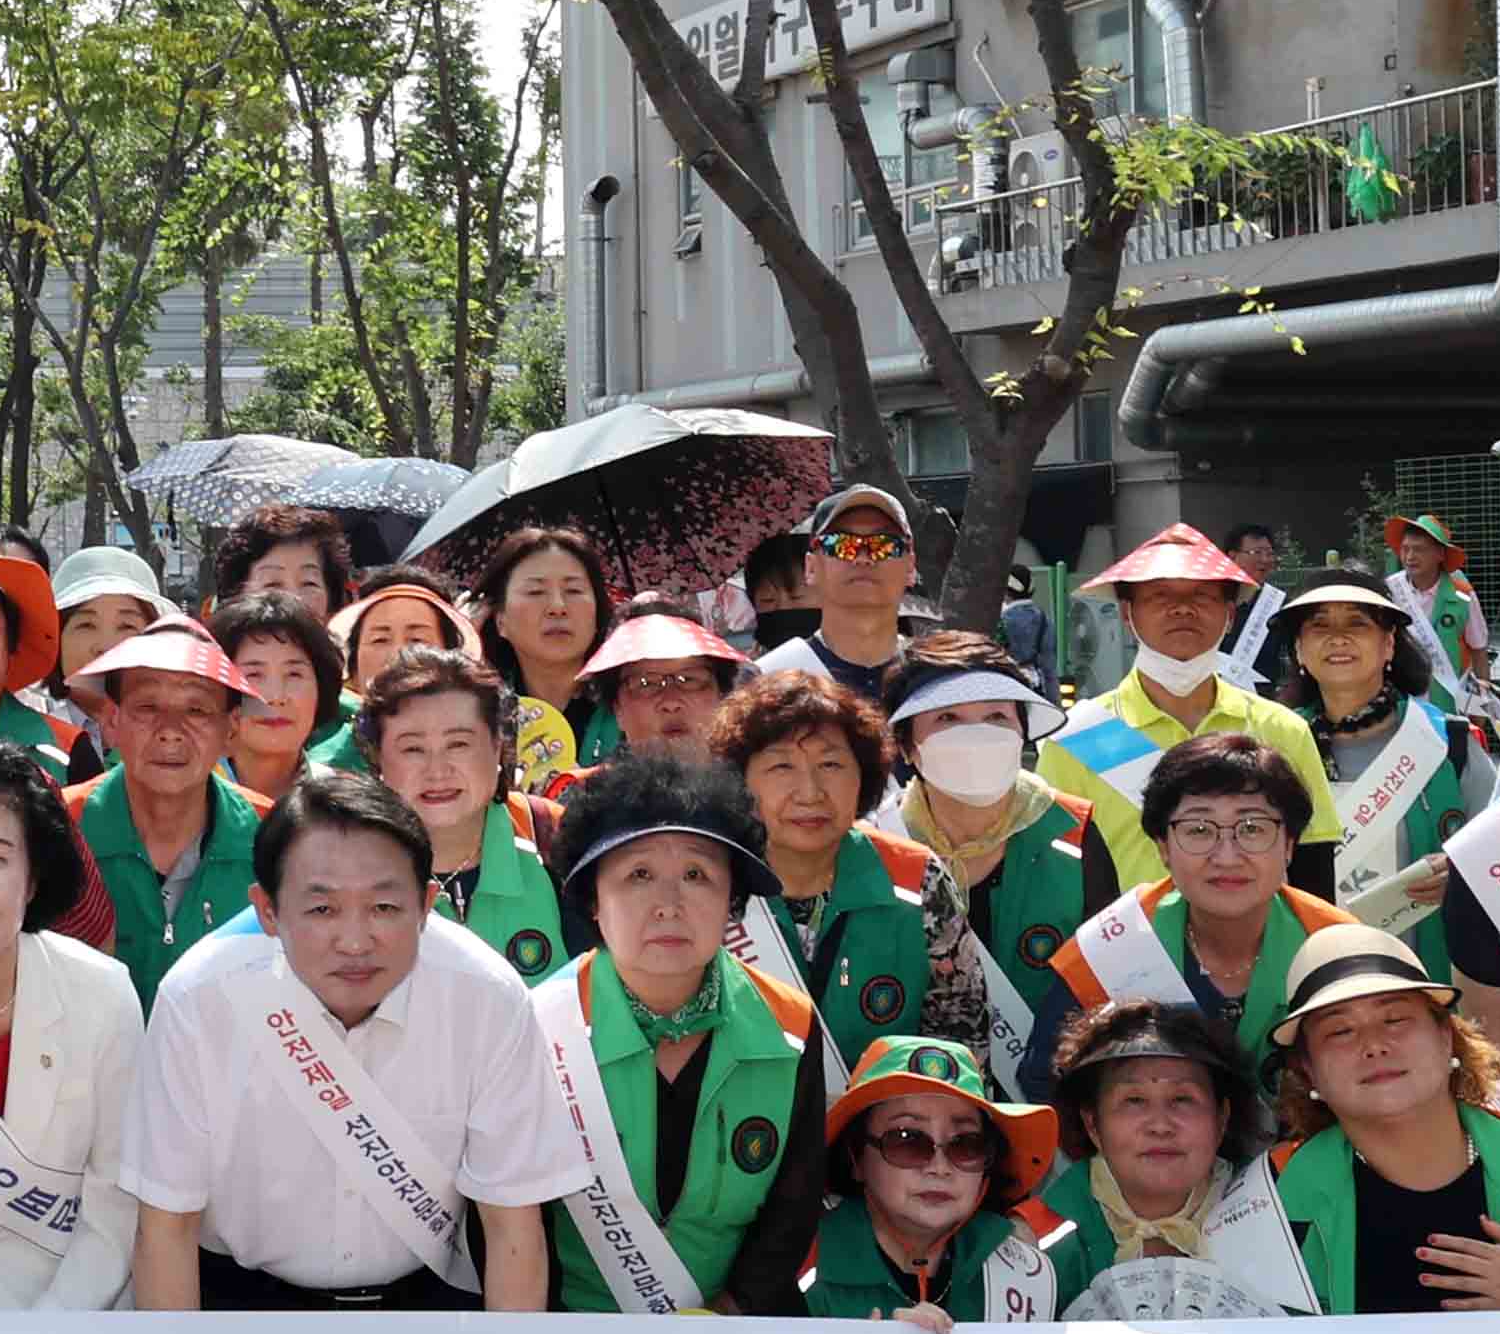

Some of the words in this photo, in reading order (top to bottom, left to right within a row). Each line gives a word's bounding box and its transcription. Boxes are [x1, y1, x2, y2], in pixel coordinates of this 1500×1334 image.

[1353, 754, 1416, 828] 안전제일
[266, 1008, 353, 1112] 안전제일
[344, 1113, 453, 1236] 선진안전문화
